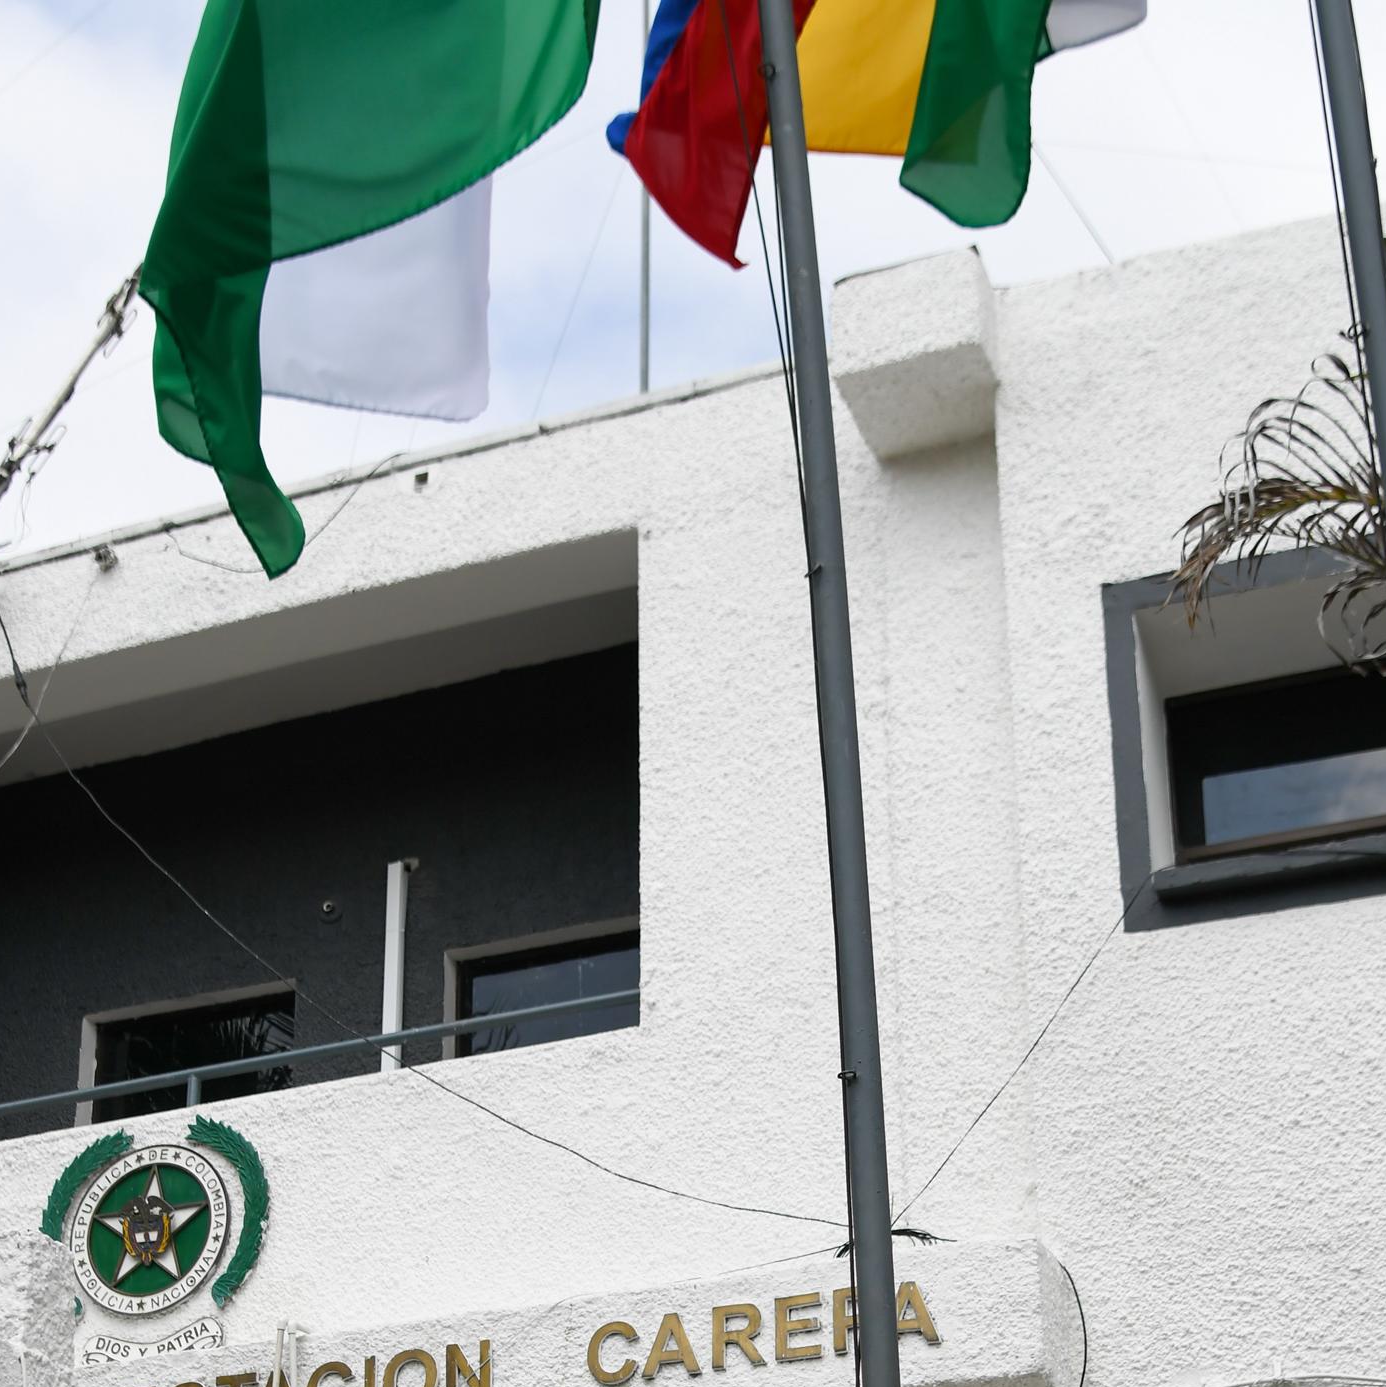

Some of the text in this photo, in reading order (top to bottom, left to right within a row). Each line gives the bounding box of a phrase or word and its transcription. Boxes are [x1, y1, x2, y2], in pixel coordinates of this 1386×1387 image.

[74, 1149, 226, 1253] REPUBLICA DE COLOMBIA
[80, 1246, 217, 1312] POLICIA NACIONAL
[95, 1322, 210, 1358] DIOS Y PATRIA
